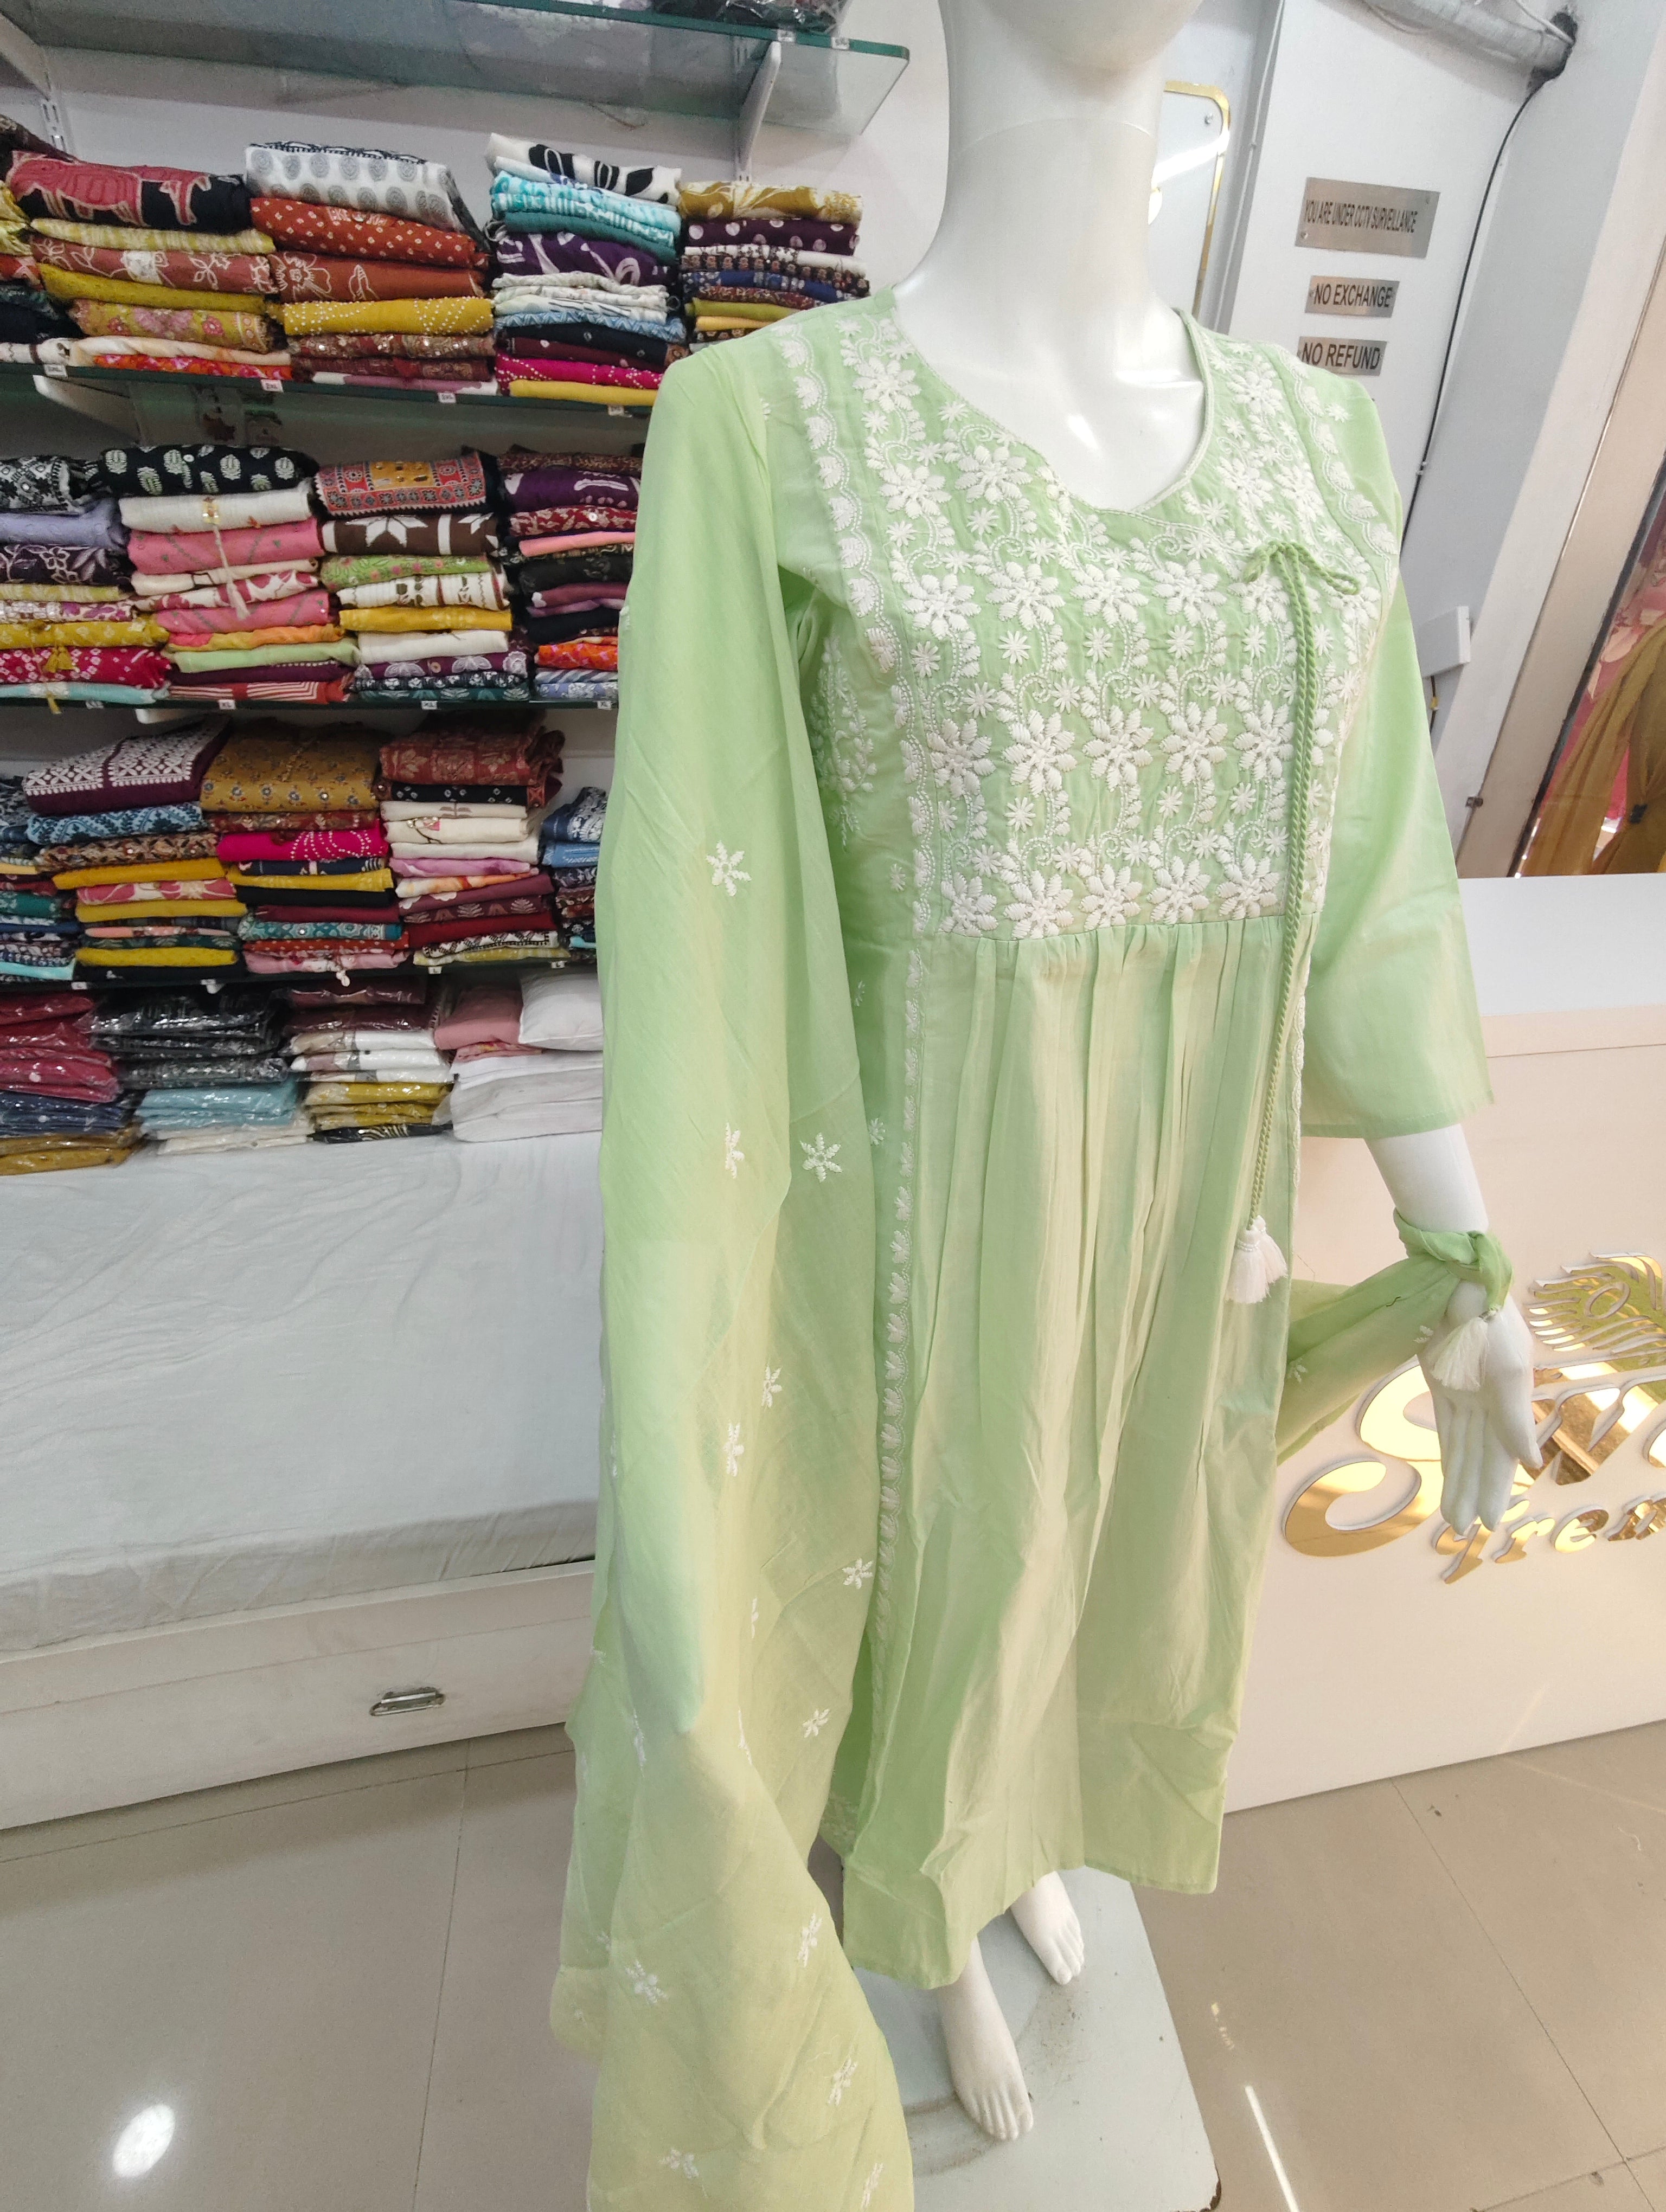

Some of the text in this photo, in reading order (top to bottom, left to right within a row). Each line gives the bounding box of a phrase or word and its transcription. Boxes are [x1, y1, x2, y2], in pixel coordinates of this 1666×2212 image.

[1304, 199, 1320, 223] YOU
[1317, 201, 1334, 225] ARE
[1331, 202, 1355, 227] UNDER
[1353, 204, 1374, 228] CCTV
[1313, 283, 1393, 307] NO EXCHANGE
[1302, 342, 1381, 370] NO REFUND
